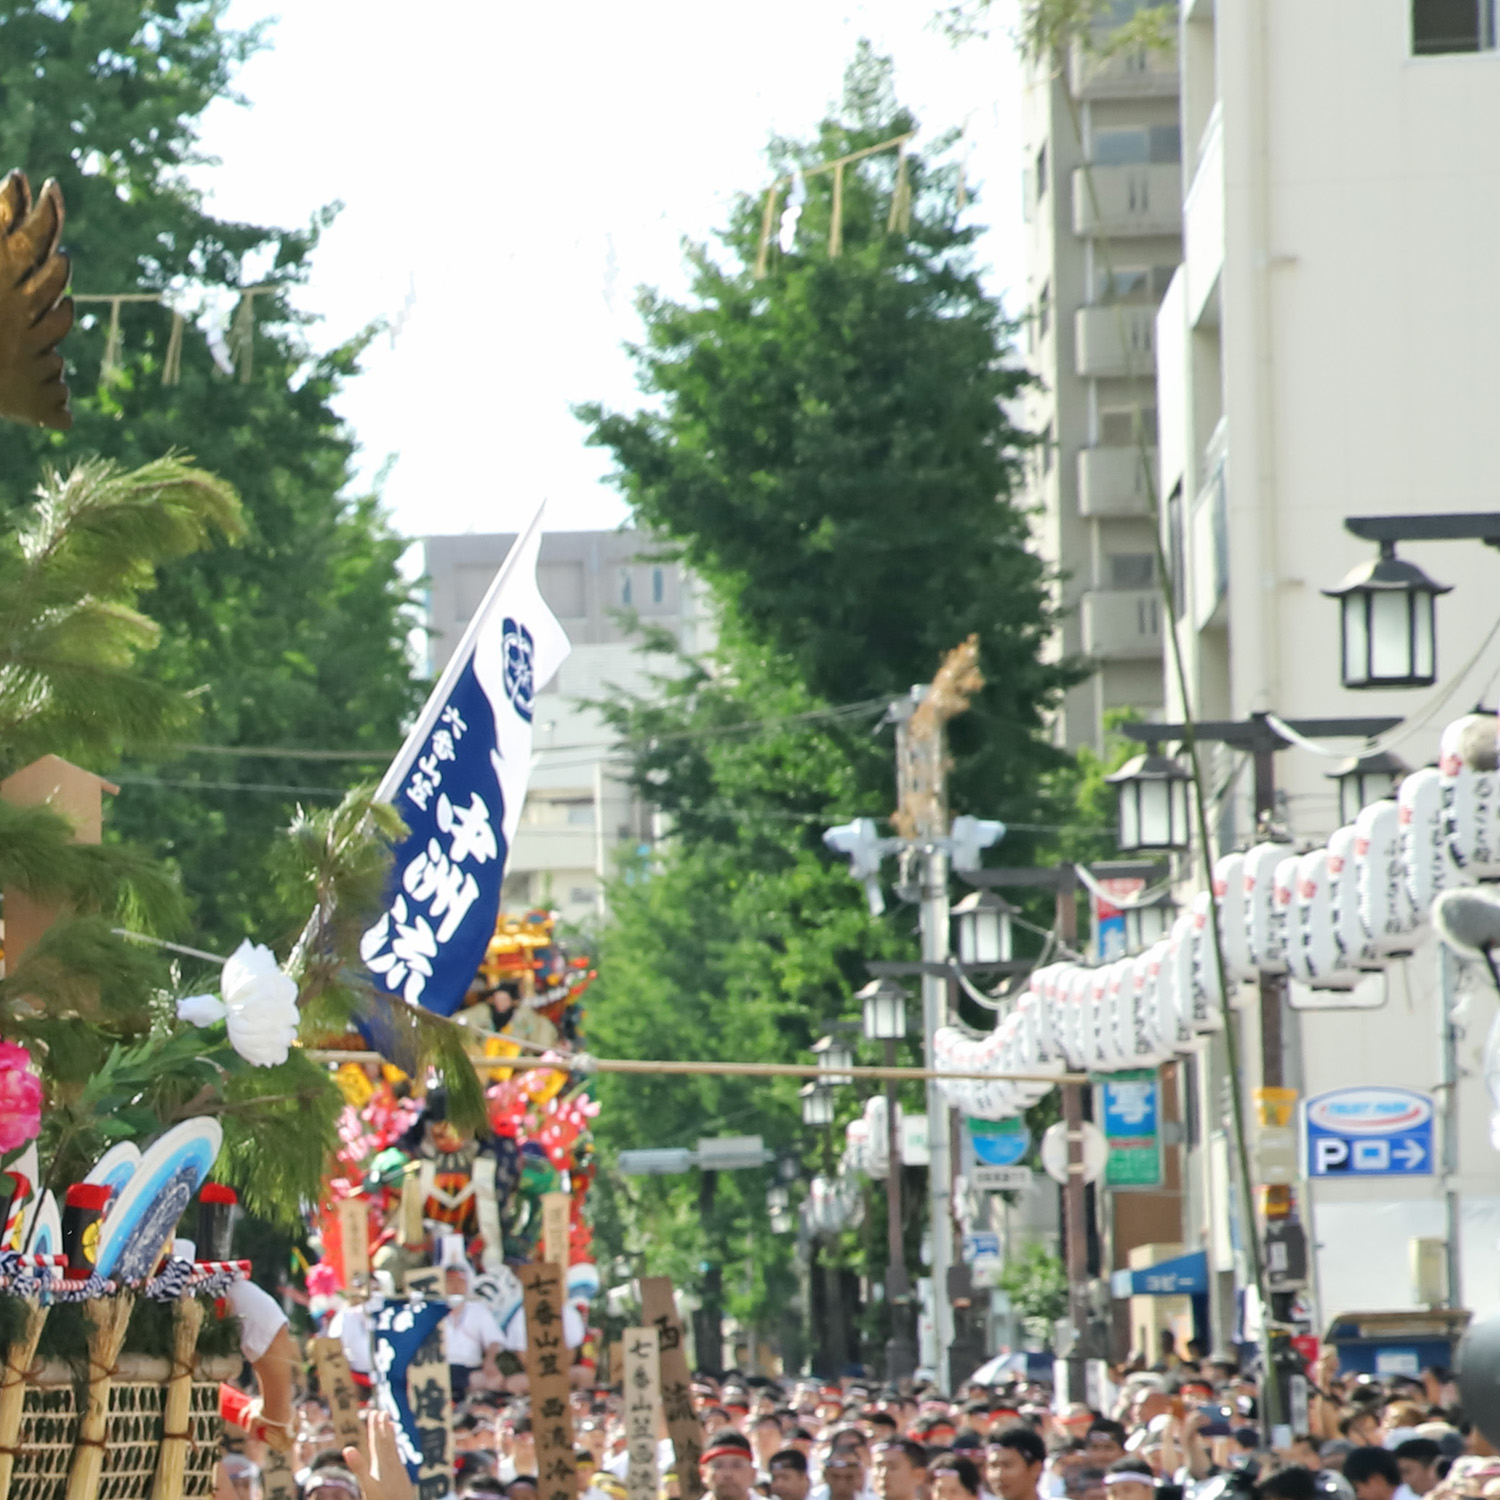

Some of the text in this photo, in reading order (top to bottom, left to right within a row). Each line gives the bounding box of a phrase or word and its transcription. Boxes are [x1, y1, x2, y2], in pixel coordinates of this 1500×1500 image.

[406, 704, 468, 811] 六番山笠
[359, 791, 498, 1006] 中洲流
[1315, 1137, 1350, 1175] P
